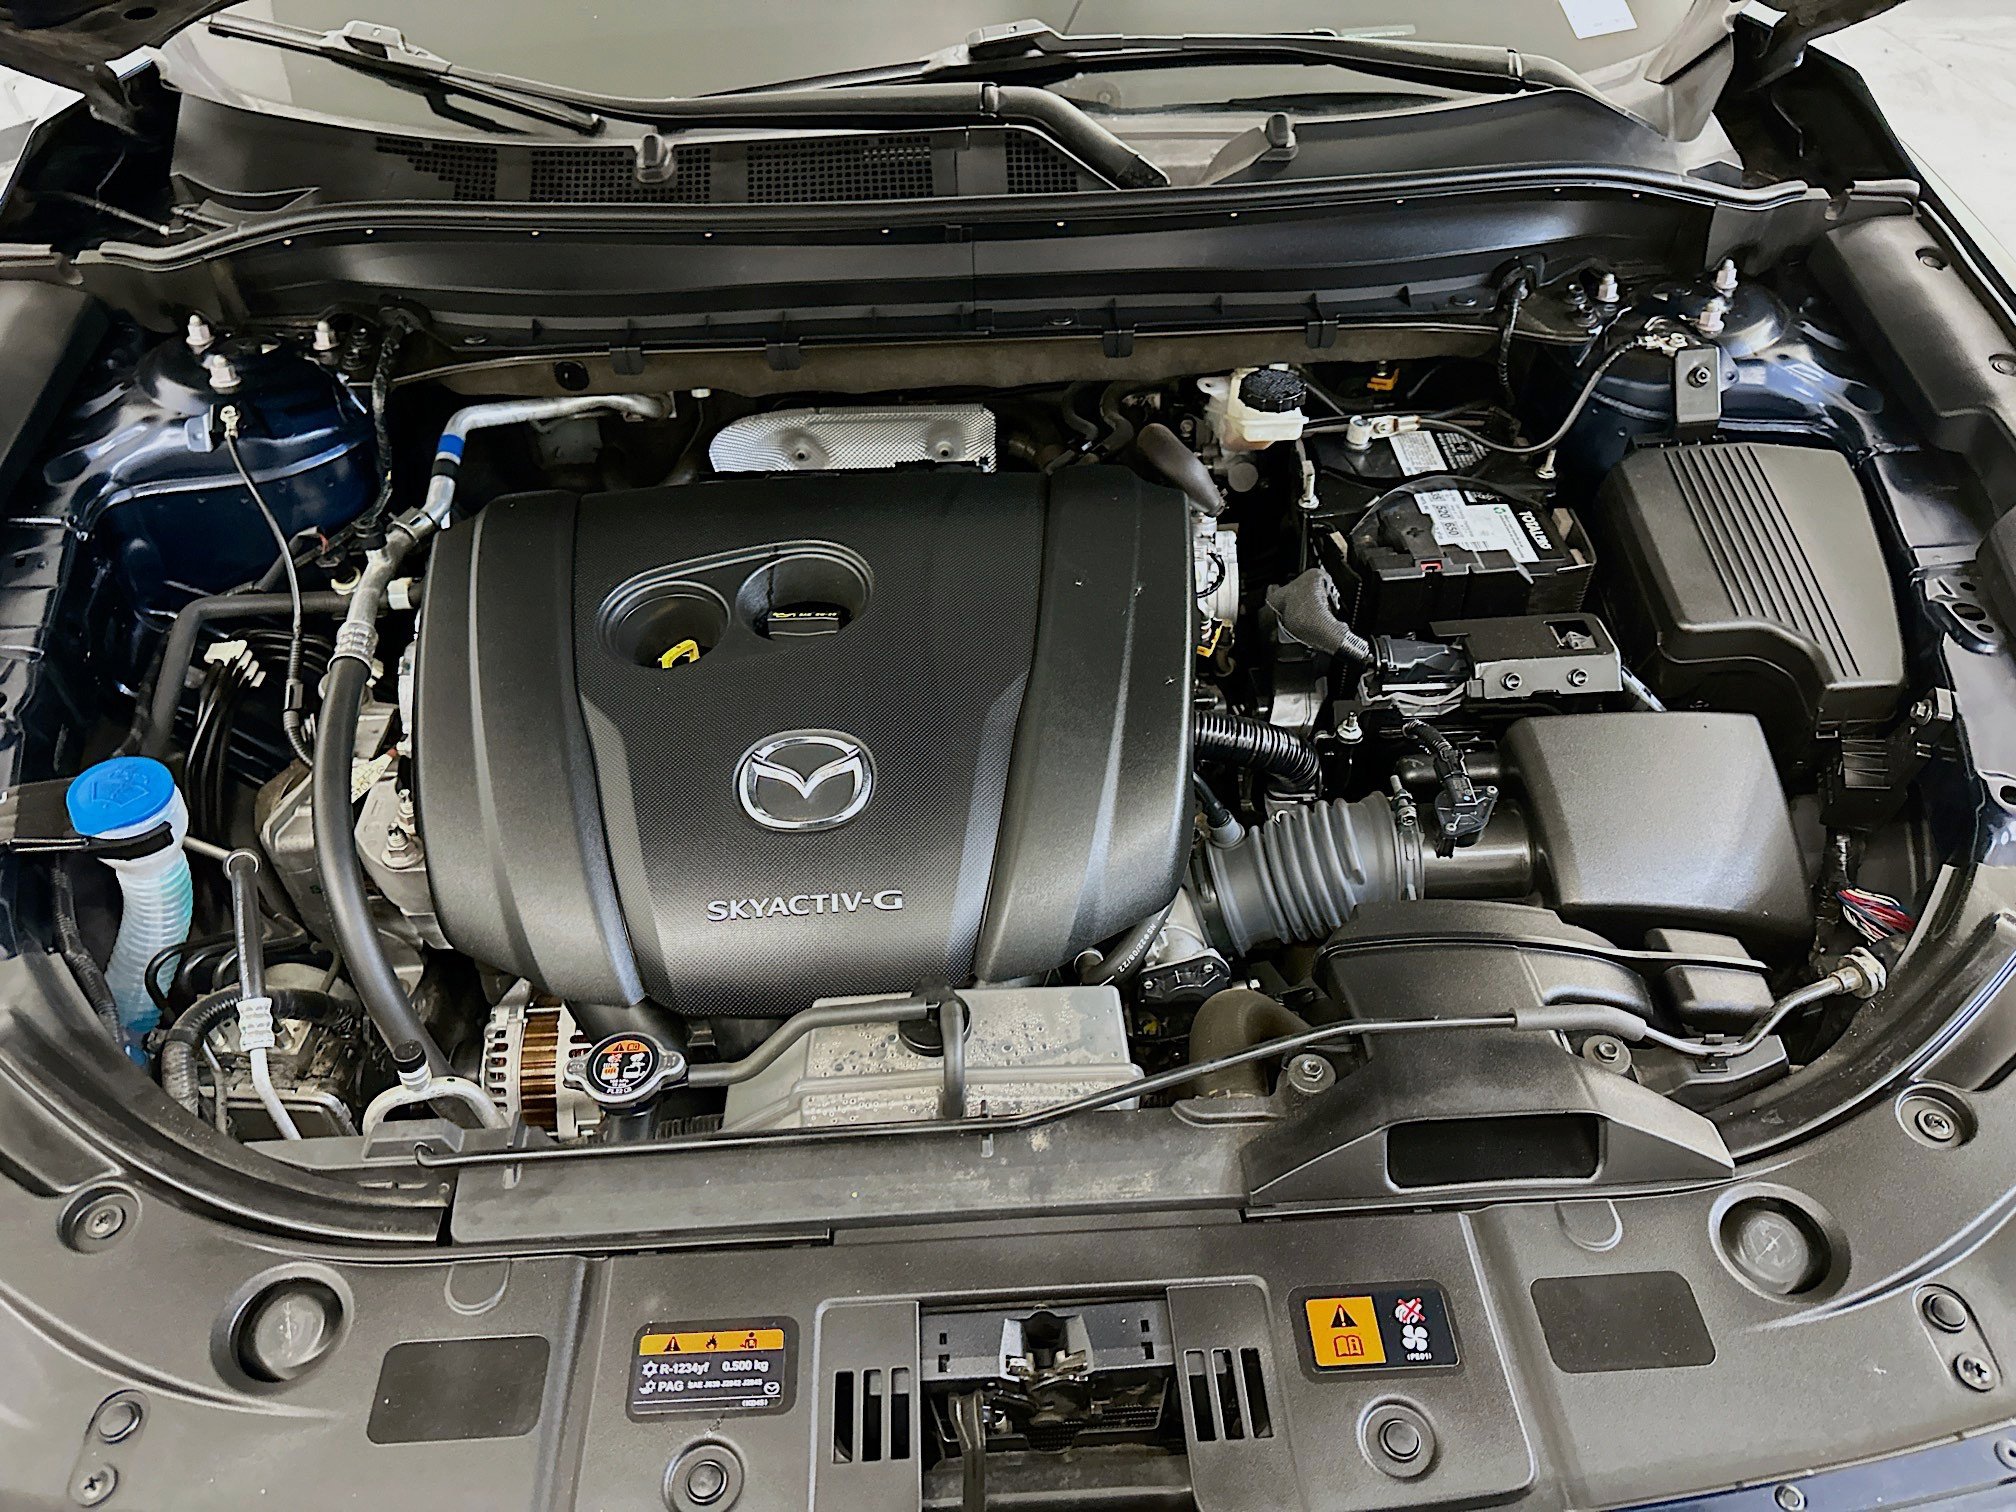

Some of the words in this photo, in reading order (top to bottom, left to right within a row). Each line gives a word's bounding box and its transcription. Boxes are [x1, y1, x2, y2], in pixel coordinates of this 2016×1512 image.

[1436, 505, 1450, 518] 520
[1445, 522, 1459, 535] 650
[707, 889, 903, 921] SKYACTIV-G
[659, 1361, 709, 1375] R-1234yf
[722, 1360, 752, 1372] 0.500
[754, 1360, 769, 1372] kg
[658, 1381, 684, 1392] PAG
